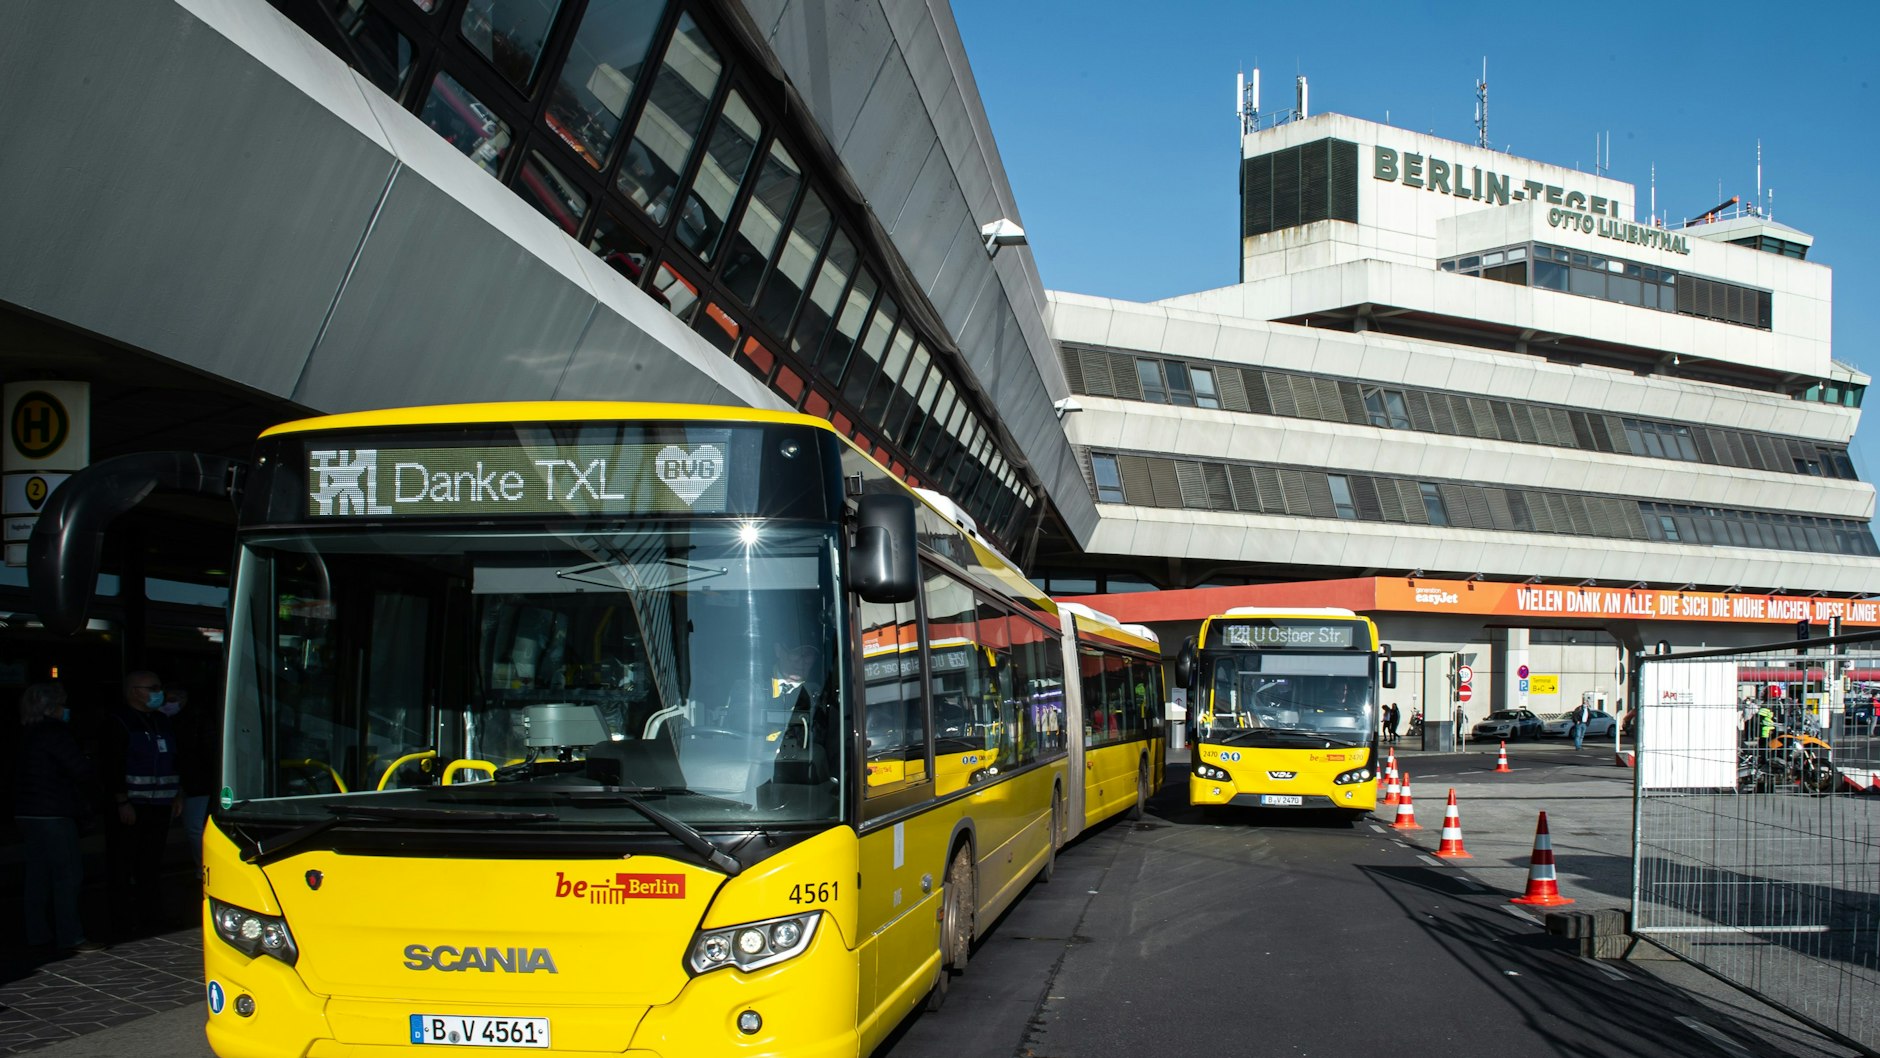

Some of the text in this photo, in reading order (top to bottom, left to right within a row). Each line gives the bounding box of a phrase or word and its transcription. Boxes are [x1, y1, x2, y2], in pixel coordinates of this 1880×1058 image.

[1547, 207, 1690, 255] OTTO LILIENTHAL
[23, 407, 50, 443] H
[33, 483, 40, 496] 2
[395, 461, 524, 503] Danke
[535, 459, 625, 501] TXL
[664, 459, 715, 479] BVG
[1415, 592, 1458, 605] easyJet
[1517, 589, 1562, 612] VIELEN
[1567, 590, 1601, 613] DANK
[1604, 592, 1621, 614] AN
[1623, 593, 1656, 618] ALLE,
[1660, 595, 1679, 616] DIE
[1682, 595, 1708, 617] SICH
[1712, 597, 1730, 618] DIE
[1733, 596, 1765, 619] MÜHE
[1767, 599, 1813, 623] MACHEN,
[1815, 601, 1844, 621] DIESE
[1846, 603, 1877, 622] LANGE
[1254, 626, 1265, 642] U
[1268, 626, 1315, 643] Osloer
[1318, 626, 1345, 644] Str.
[1203, 750, 1218, 758] 2470
[1283, 796, 1300, 804] 2470
[555, 872, 680, 898] be Berlin
[788, 881, 840, 904] 4561
[403, 943, 559, 974] SCANIA
[415, 1018, 538, 1044] D B V 4561
